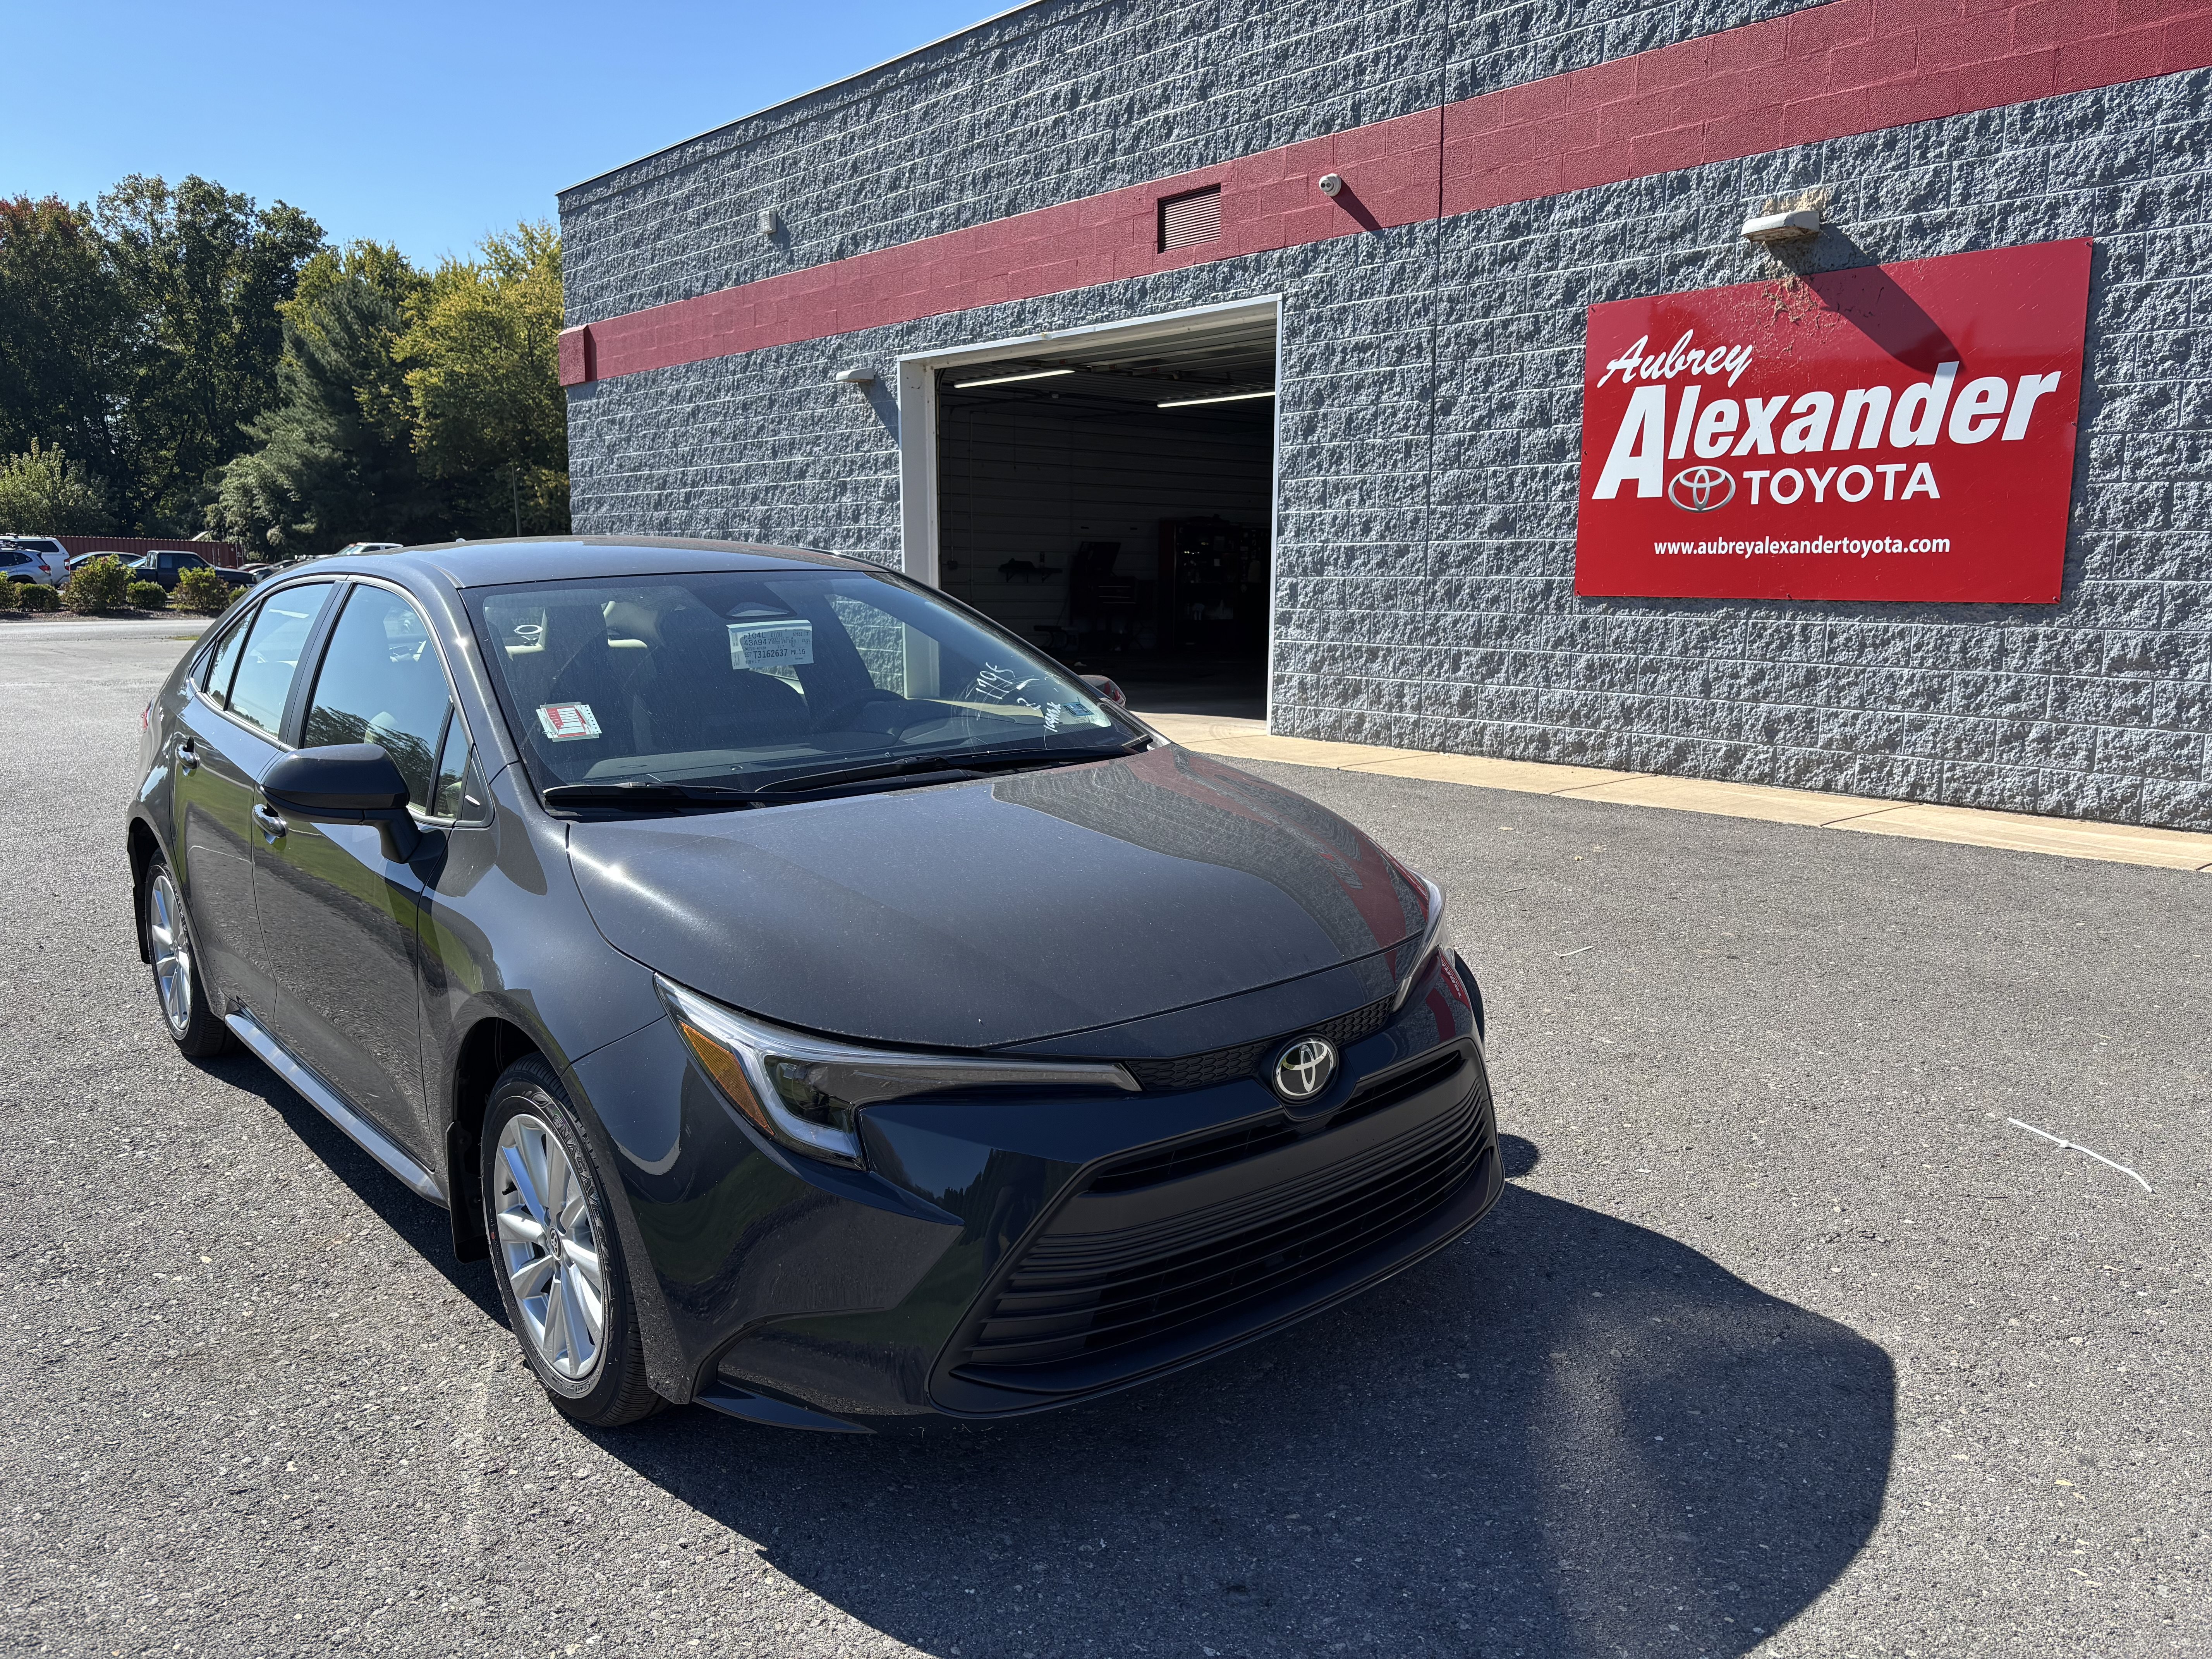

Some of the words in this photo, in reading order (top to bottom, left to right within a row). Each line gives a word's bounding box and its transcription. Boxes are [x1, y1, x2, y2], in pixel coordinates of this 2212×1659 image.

[1596, 328, 1753, 388] Aubrey
[1591, 361, 2062, 500] Alexander
[1743, 462, 1941, 505] TOYOTA
[1654, 535, 1950, 559] www.aubreyalexandertoyota.com
[753, 649, 788, 659] T3162637
